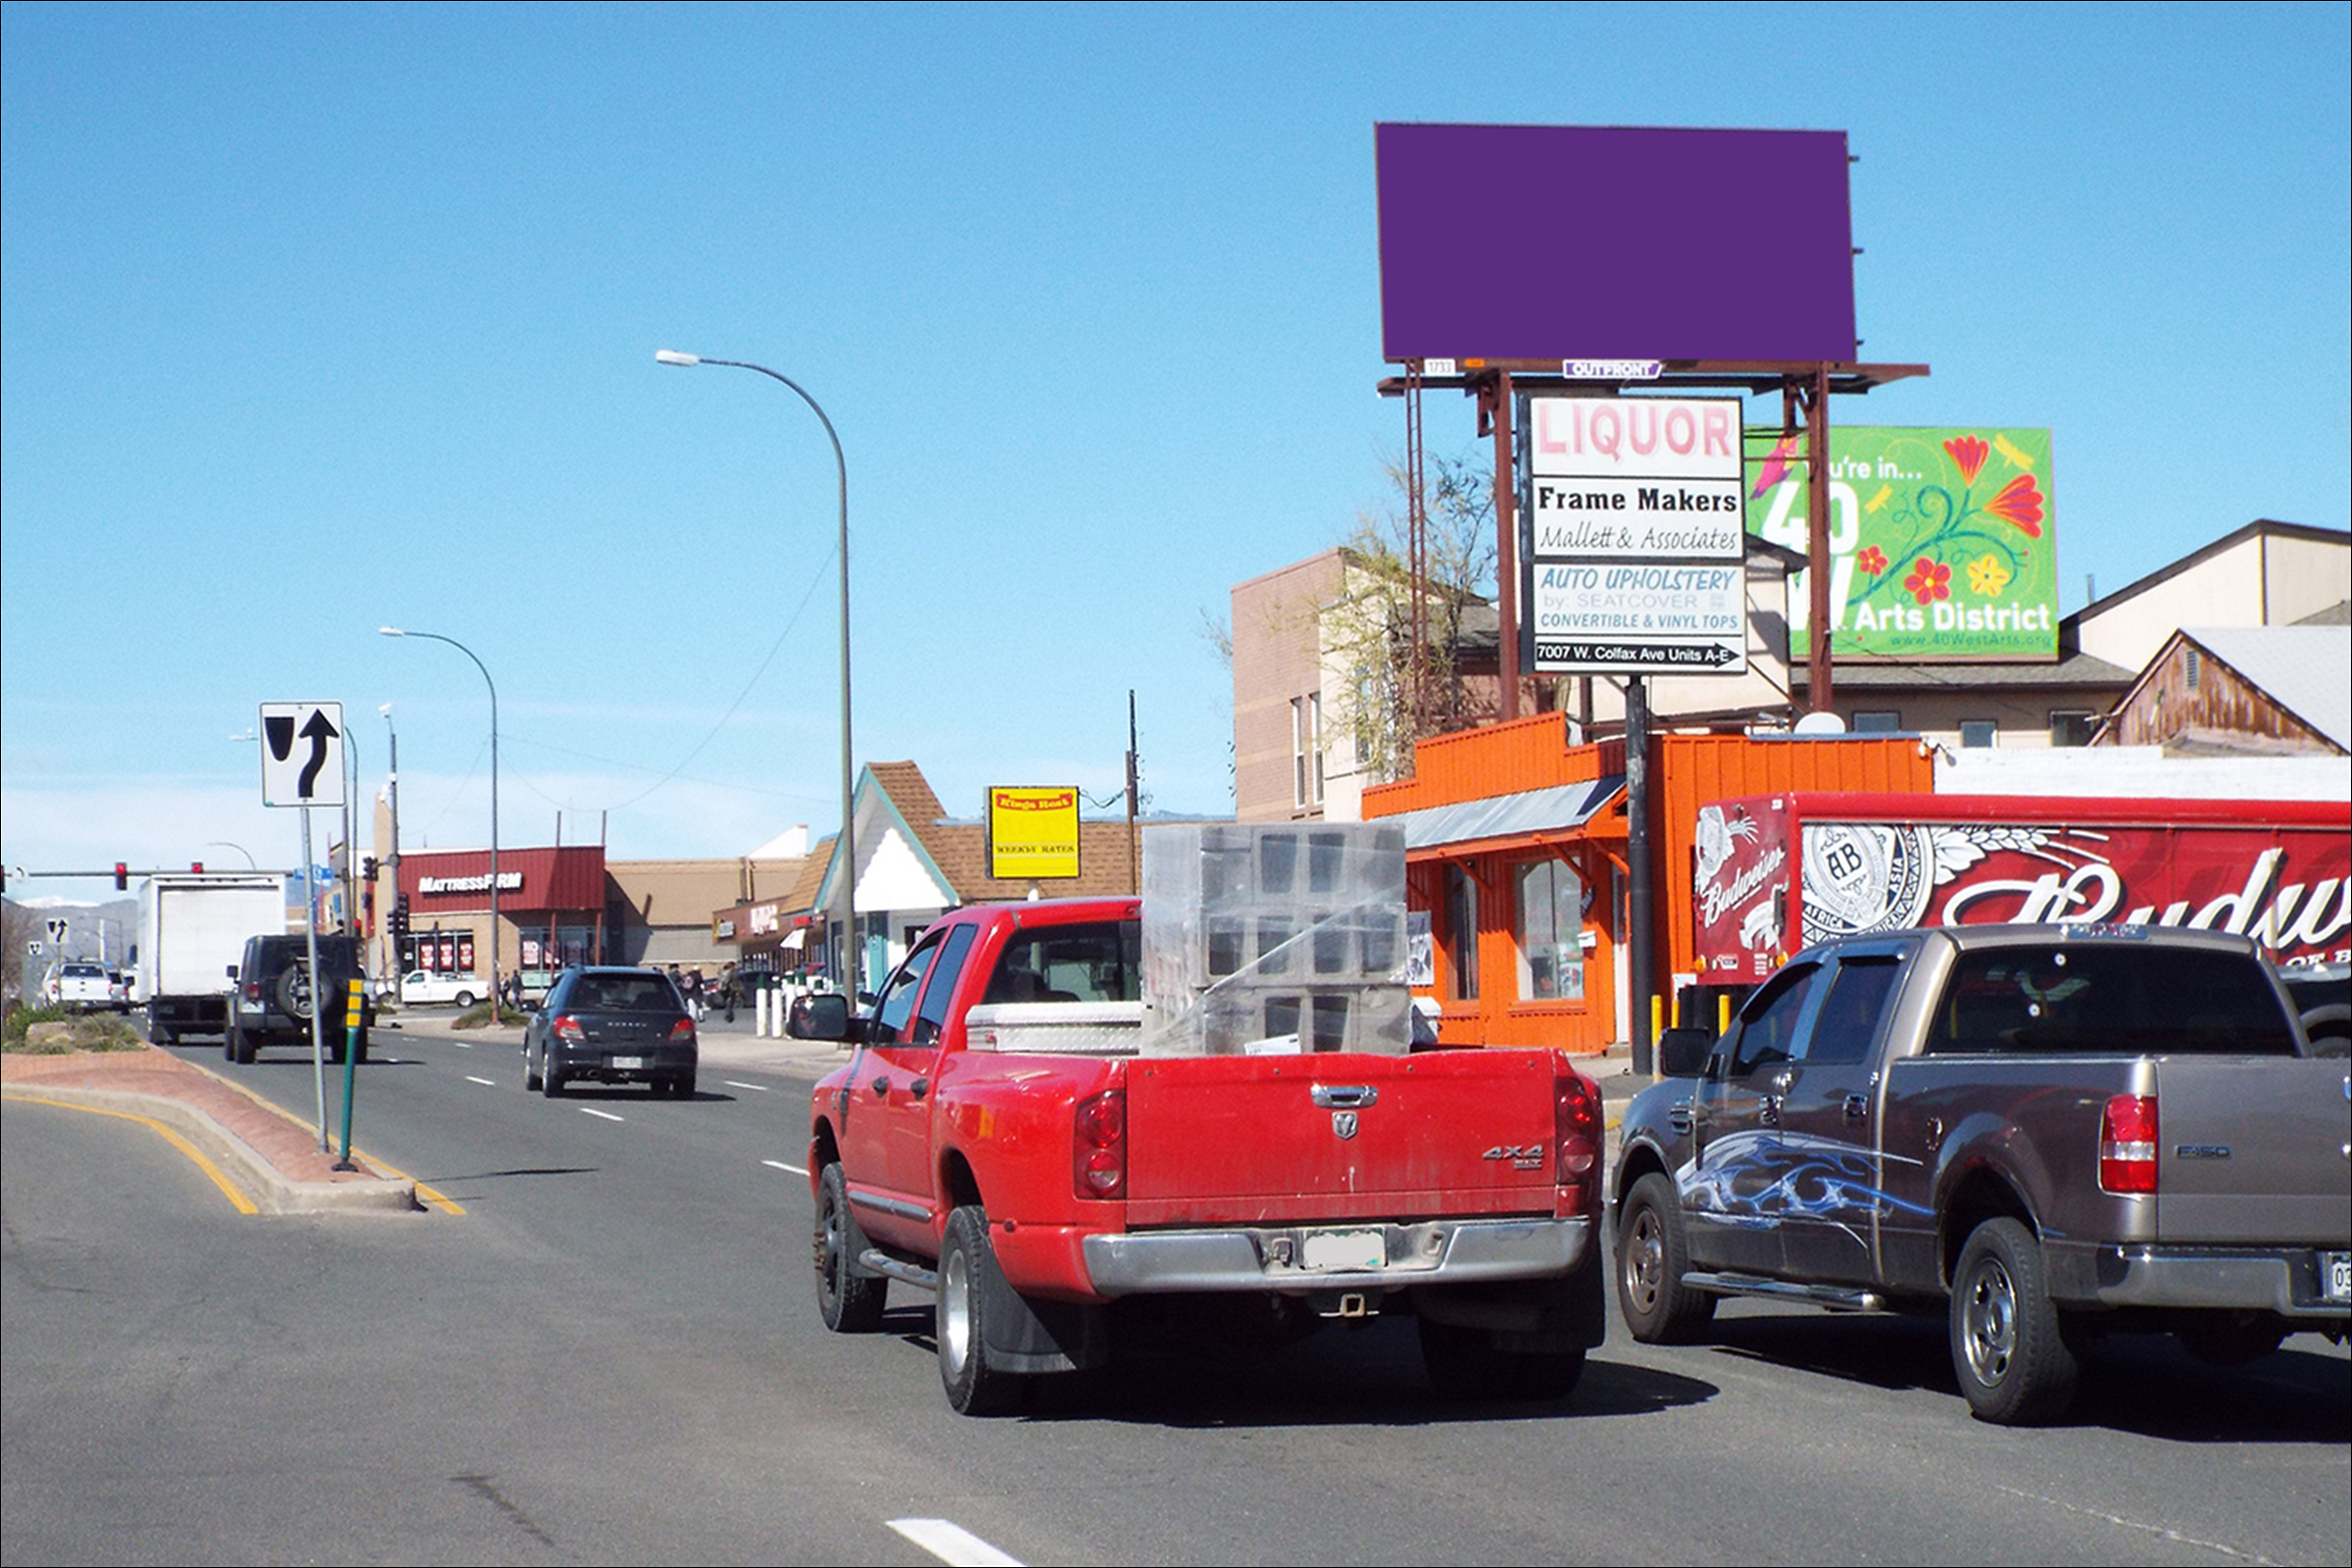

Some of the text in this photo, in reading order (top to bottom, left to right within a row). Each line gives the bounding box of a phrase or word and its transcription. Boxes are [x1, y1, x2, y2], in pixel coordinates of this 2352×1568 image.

[1428, 361, 1452, 372] 1733
[1572, 362, 1653, 376] OUTFRONT
[1536, 402, 1733, 463] LIQUOR
[1877, 455, 1923, 479] in...
[1539, 486, 1738, 513] Frame Makers
[1761, 480, 1860, 556] 40
[1540, 520, 1739, 551] Mallett & Associates
[1541, 567, 1737, 592] AUTO UPHOLSTERY
[1544, 594, 1570, 611] by:
[1577, 593, 1698, 610] SEATCOVER
[1541, 612, 1739, 629] CONVERTIBLE & VINYL TOPS
[1854, 601, 2051, 632] Arts District
[1889, 632, 2053, 648] www.40WestArts.org
[1538, 645, 1729, 662] 7007 W. Colfax Ave Units A-E
[1826, 842, 1862, 881] AB
[418, 871, 522, 893] MATTRESSFRM
[1699, 846, 1787, 929] Budweiser
[1888, 858, 1904, 893] ASIA
[1804, 906, 1844, 930] AFRICA
